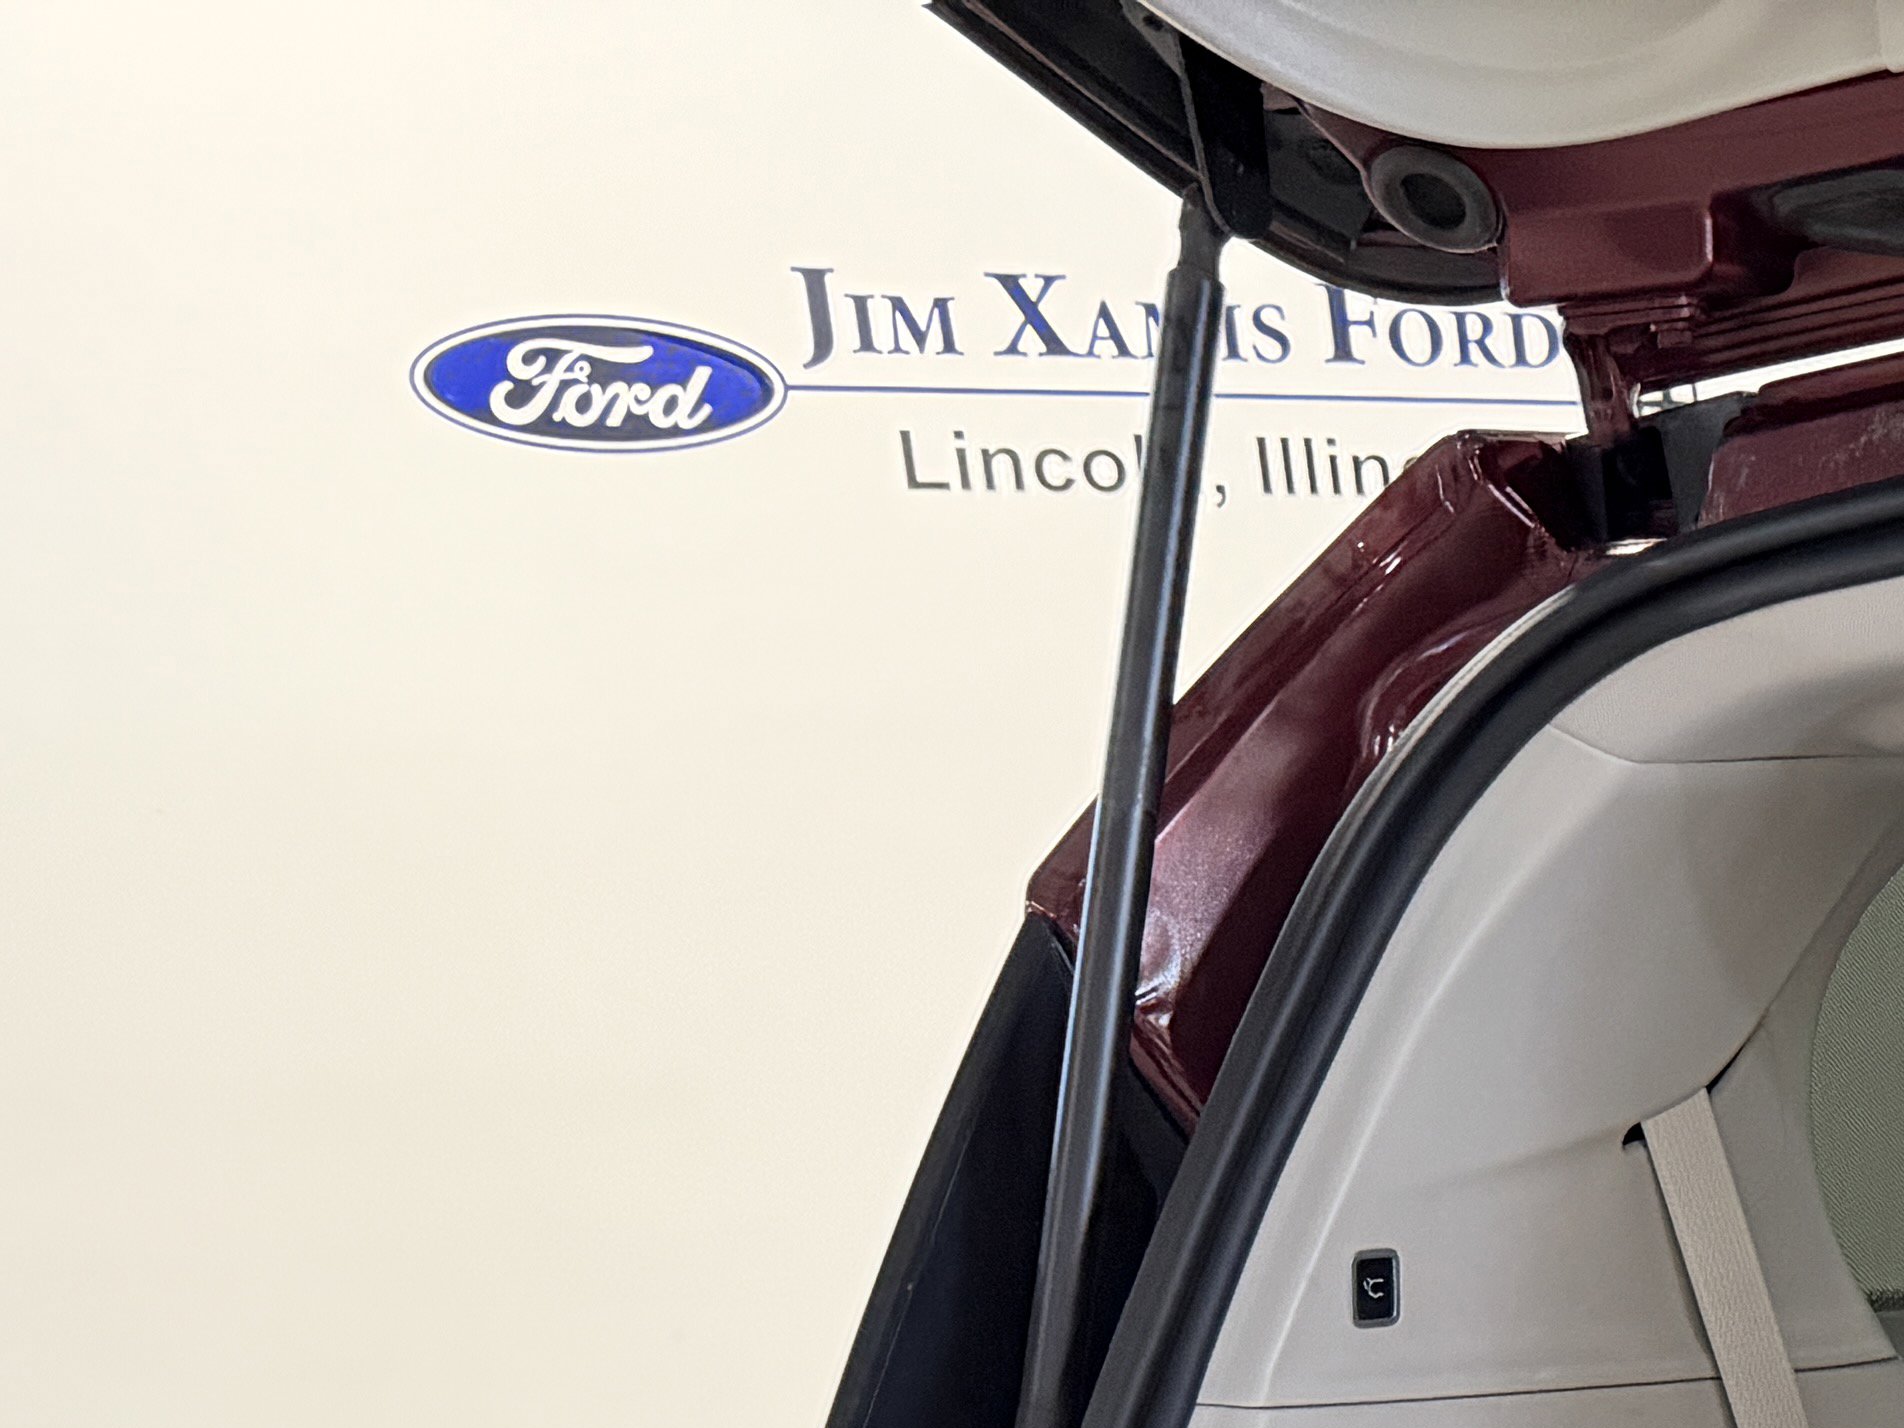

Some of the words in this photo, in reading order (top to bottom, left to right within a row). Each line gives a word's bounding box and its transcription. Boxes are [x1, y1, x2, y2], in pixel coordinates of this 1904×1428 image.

[790, 266, 964, 369] JIM
[1315, 283, 1560, 368] FORD
[899, 430, 1227, 508] Lincol,
[1256, 437, 1418, 496] Illin
